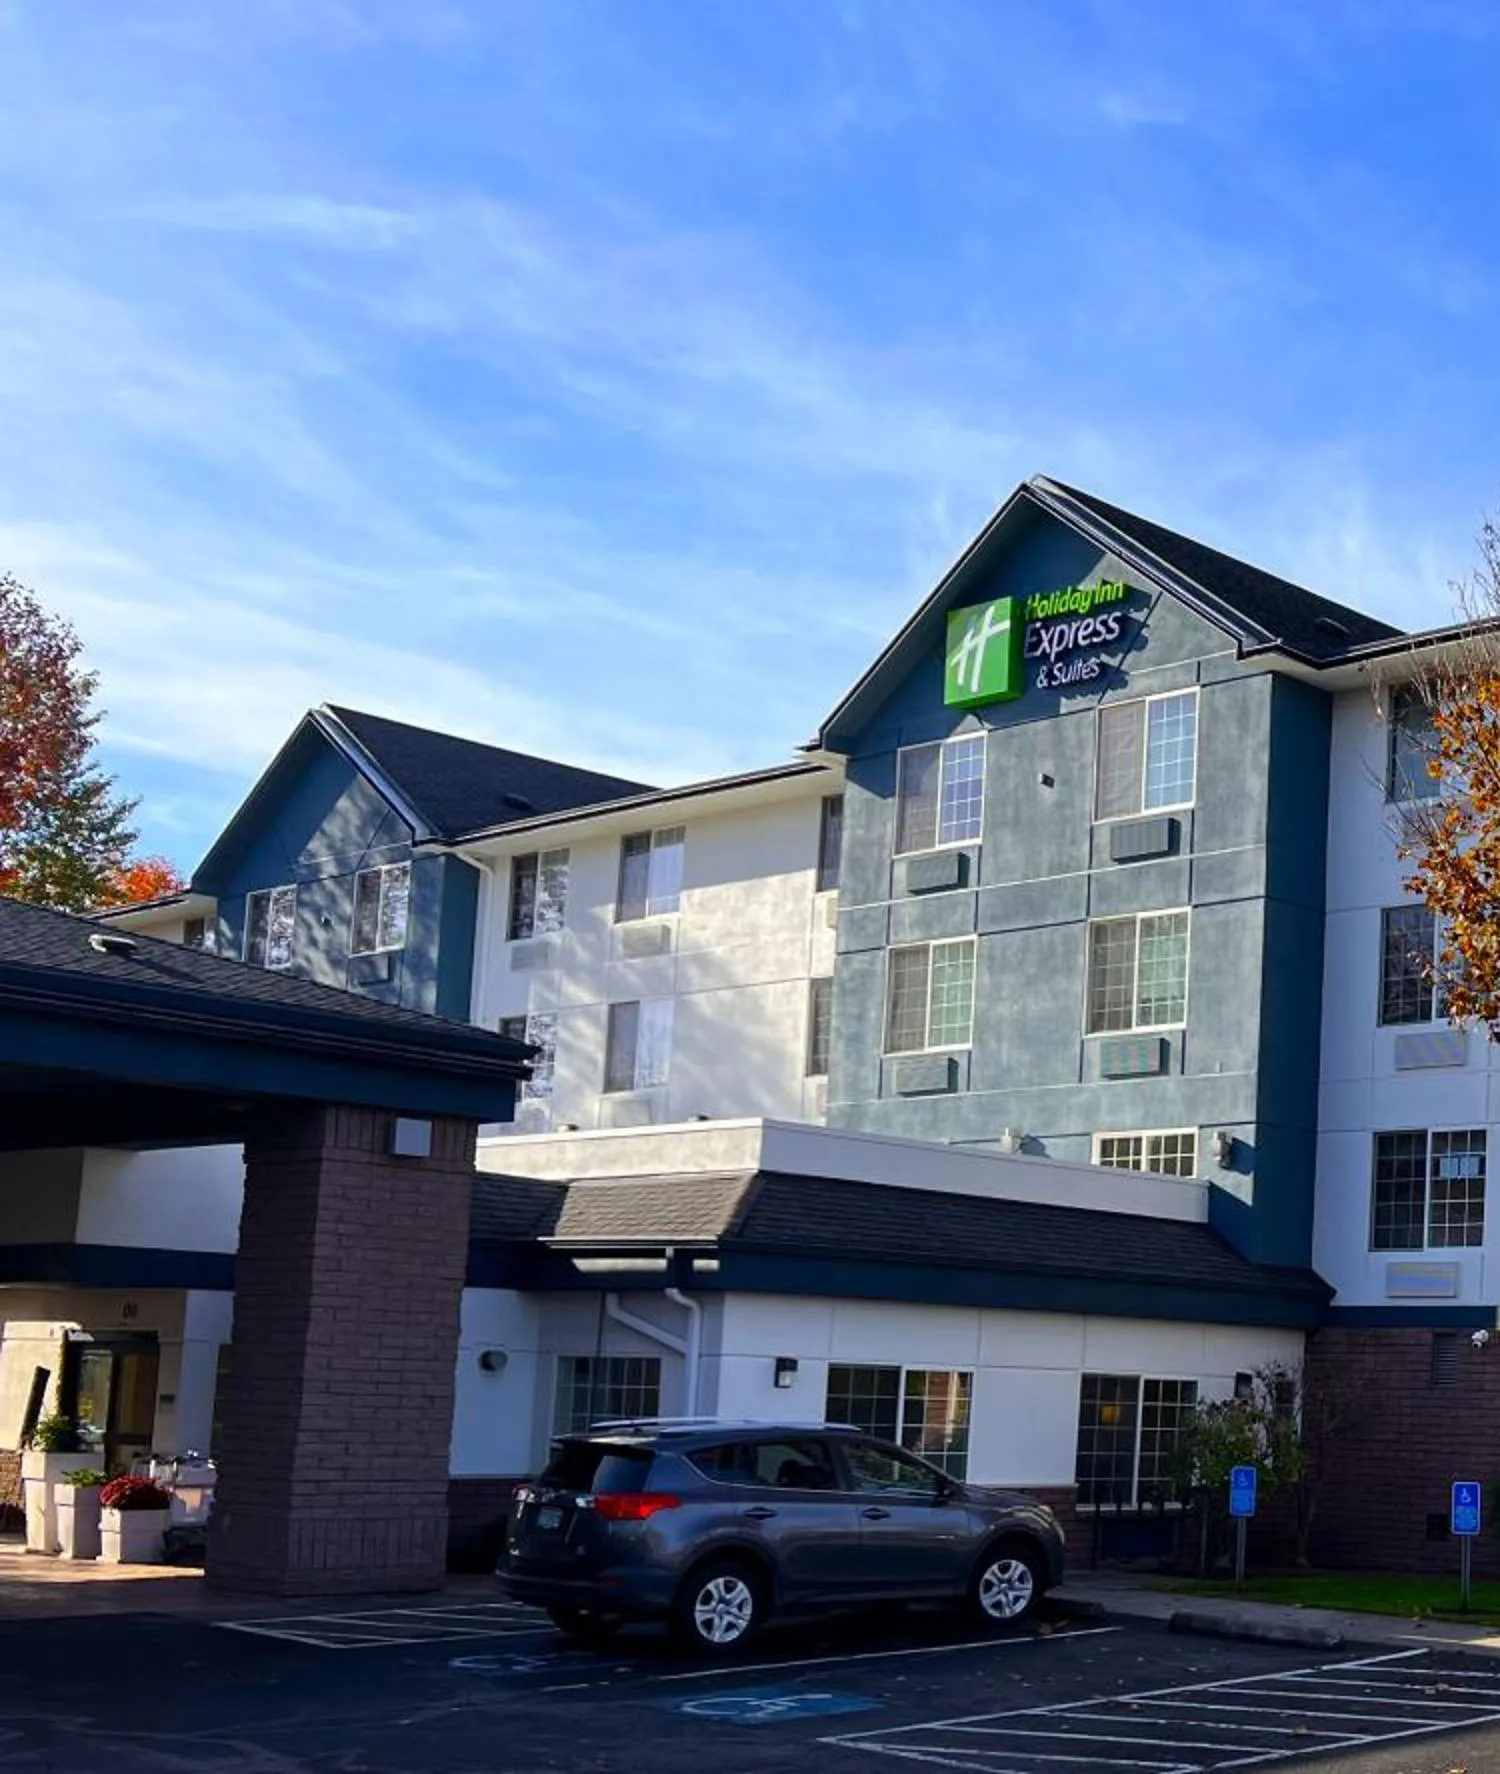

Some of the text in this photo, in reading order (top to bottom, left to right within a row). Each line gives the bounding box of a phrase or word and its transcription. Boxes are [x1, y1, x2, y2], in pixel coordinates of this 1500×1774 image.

[1024, 577, 1124, 620] Holiday Inn
[1024, 611, 1122, 662] Express
[1036, 658, 1100, 688] & Suites
